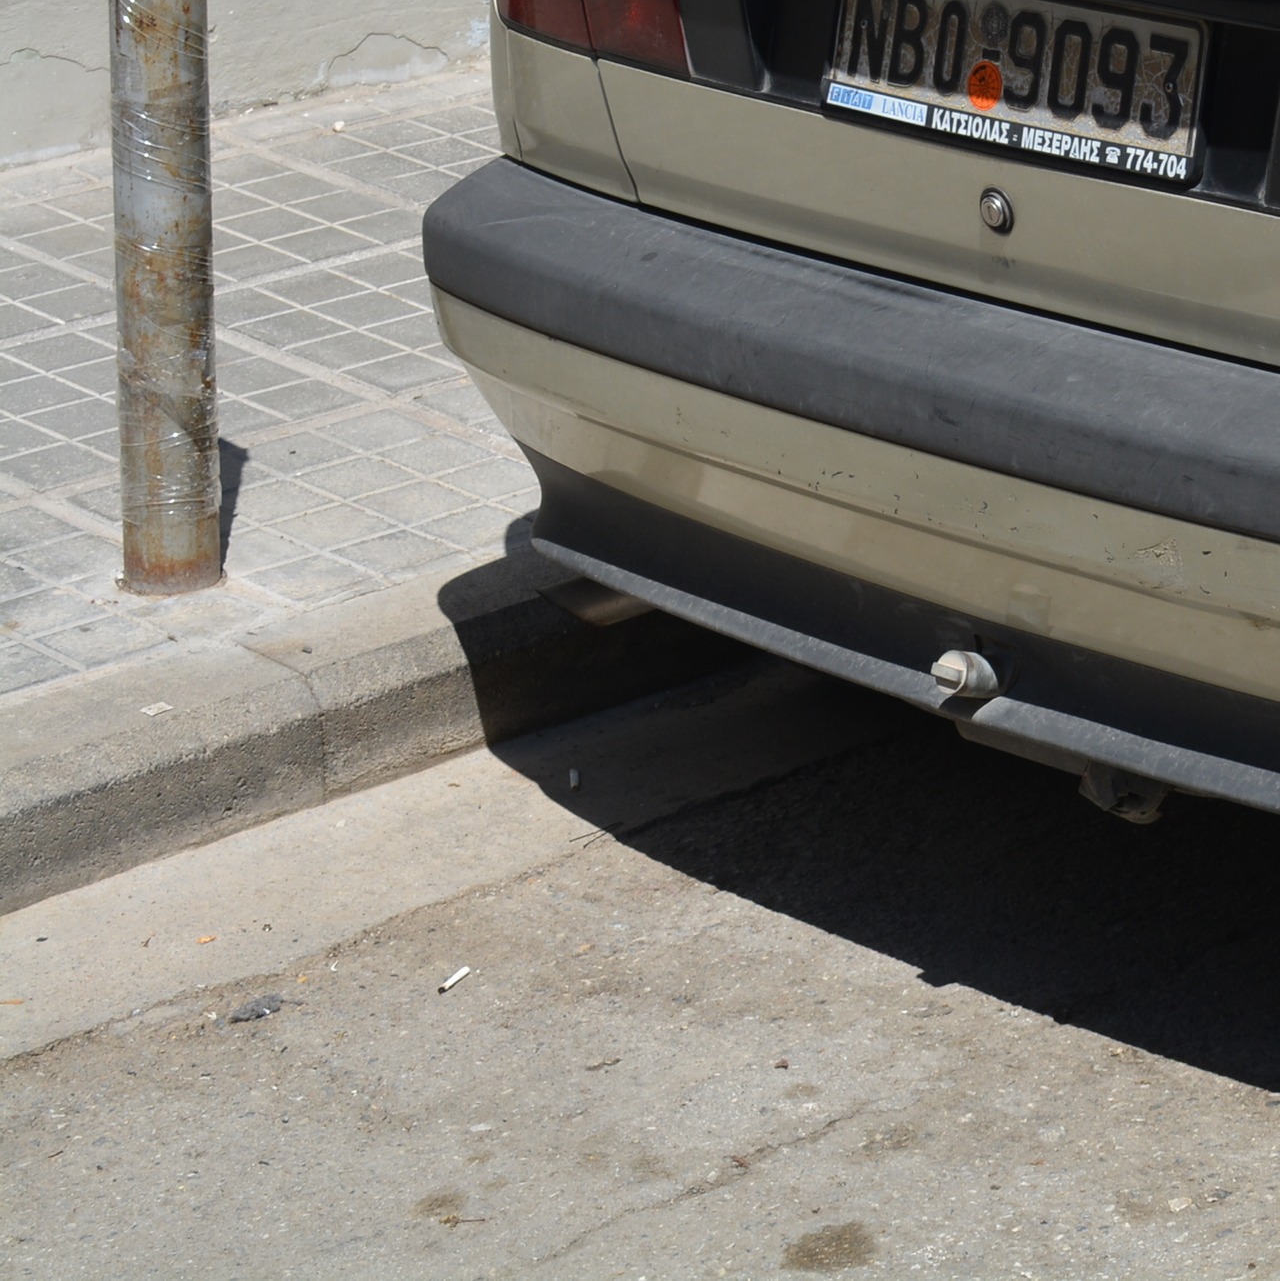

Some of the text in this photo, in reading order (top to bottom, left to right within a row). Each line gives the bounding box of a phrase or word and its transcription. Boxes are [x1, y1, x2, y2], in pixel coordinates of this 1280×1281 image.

[831, 86, 925, 123] FIAT LANCIA
[931, 107, 1011, 145] ΚΑΤΣΙΟΛΑΣ
[1021, 126, 1102, 163] ΜΕΣΕΡΔΗΣ
[1126, 147, 1187, 179] 774-704
